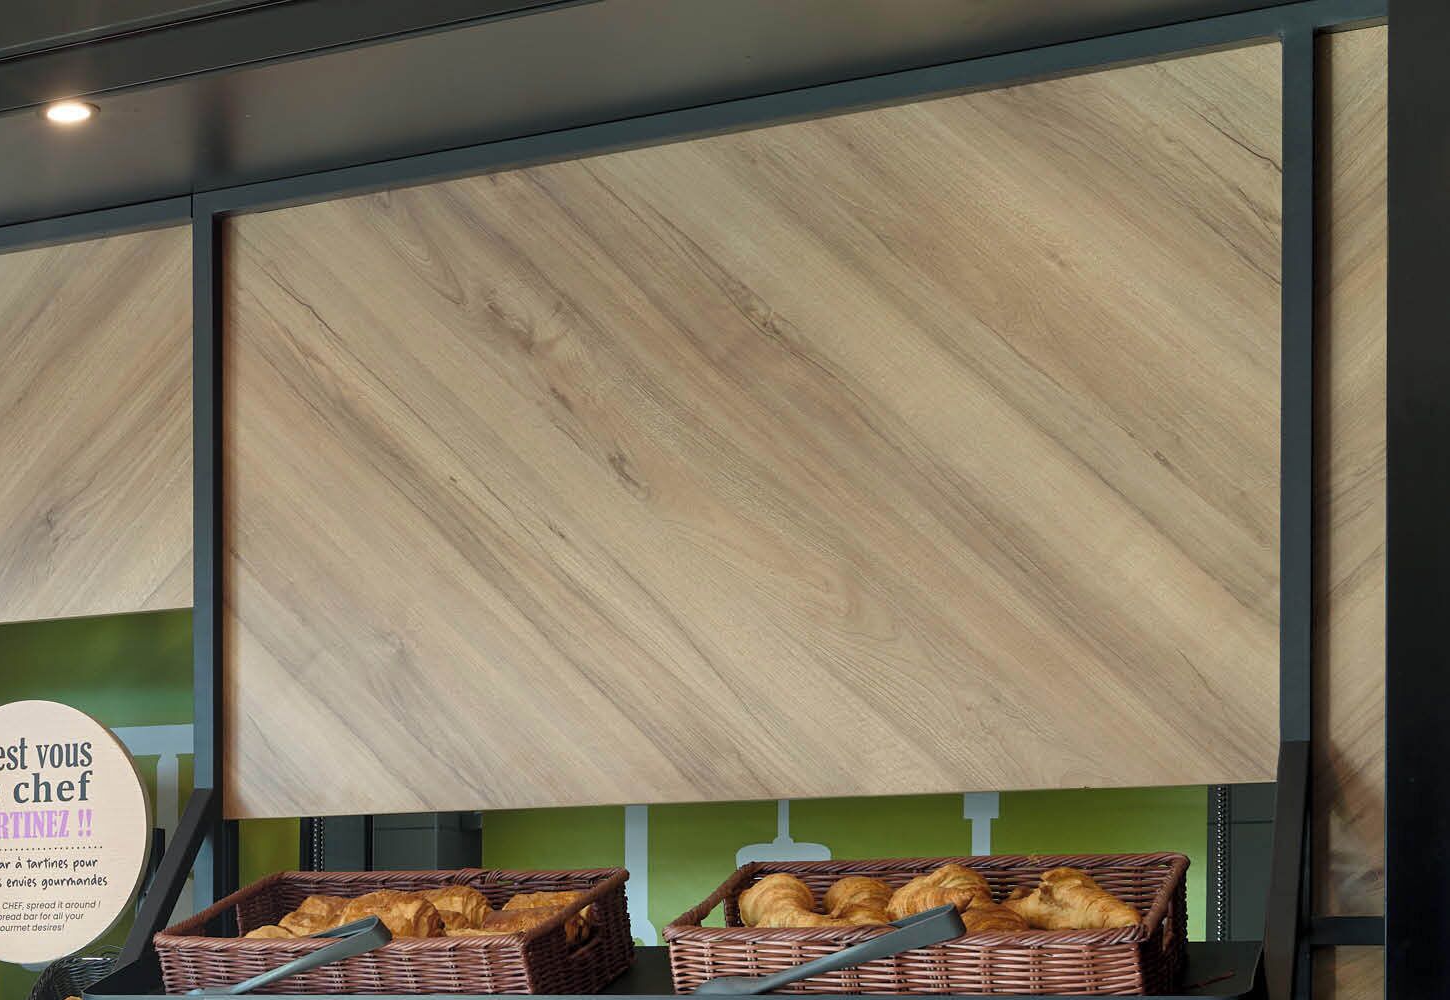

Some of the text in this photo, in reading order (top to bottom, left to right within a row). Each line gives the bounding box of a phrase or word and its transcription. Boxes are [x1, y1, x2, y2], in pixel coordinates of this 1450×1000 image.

[36, 742, 93, 769] vous
[13, 770, 93, 804] chef
[78, 808, 92, 838] !!
[15, 856, 22, 869] à
[27, 857, 68, 869] tartines
[73, 859, 98, 872] pour
[6, 876, 37, 888] envies
[41, 874, 108, 890] gourmandes
[2, 902, 25, 911] CHEF,
[26, 901, 56, 913] spread
[65, 901, 96, 909] around
[23, 913, 38, 921] bar
[39, 913, 51, 921] for
[52, 912, 63, 920] all
[64, 913, 84, 923] your
[32, 924, 64, 933] desires!
